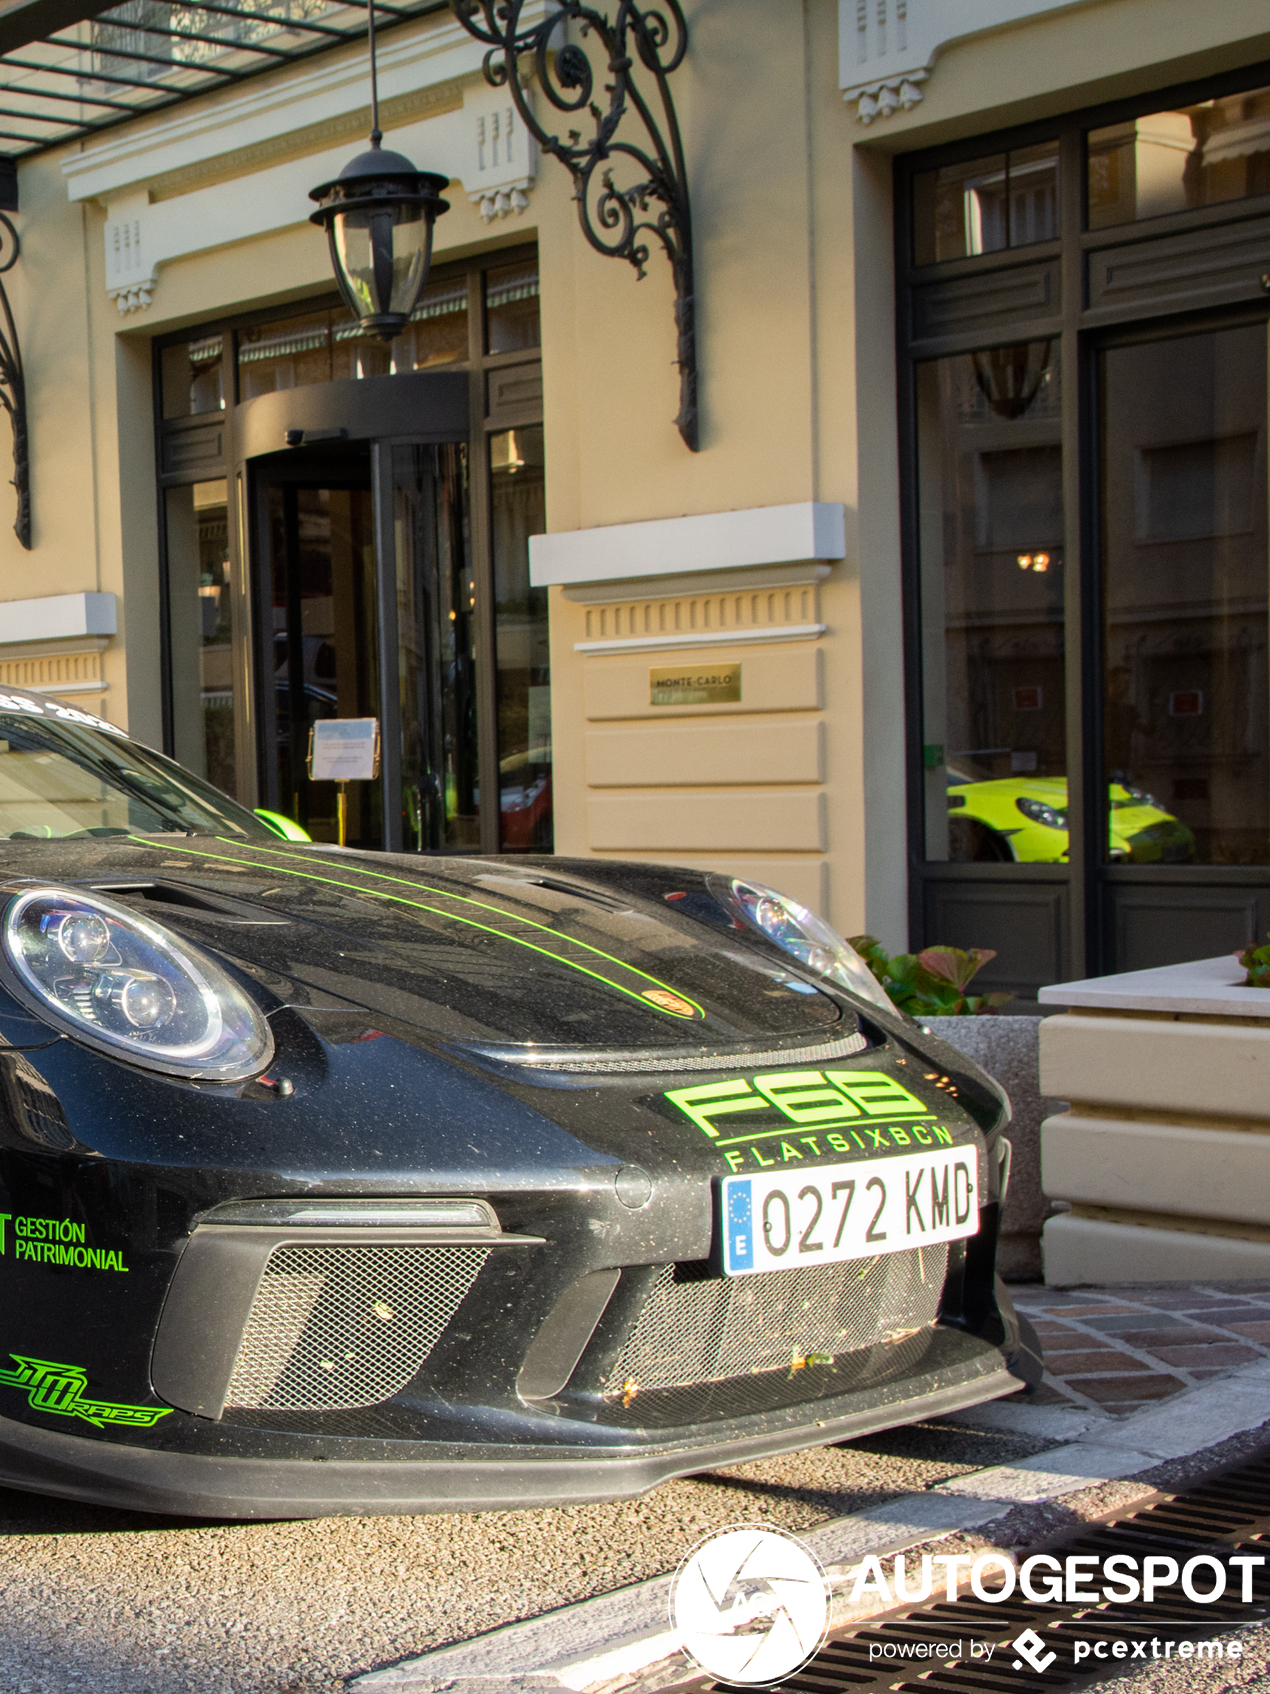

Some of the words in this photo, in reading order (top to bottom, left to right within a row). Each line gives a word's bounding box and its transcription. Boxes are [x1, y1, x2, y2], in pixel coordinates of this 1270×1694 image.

[723, 1125, 953, 1173] FLATSIXBCN
[762, 1176, 887, 1257] 0272
[905, 1161, 970, 1235] KMD
[14, 1216, 86, 1244] GESTIÓN
[735, 1234, 747, 1256] E
[15, 1239, 130, 1272] PATRIMONIAL
